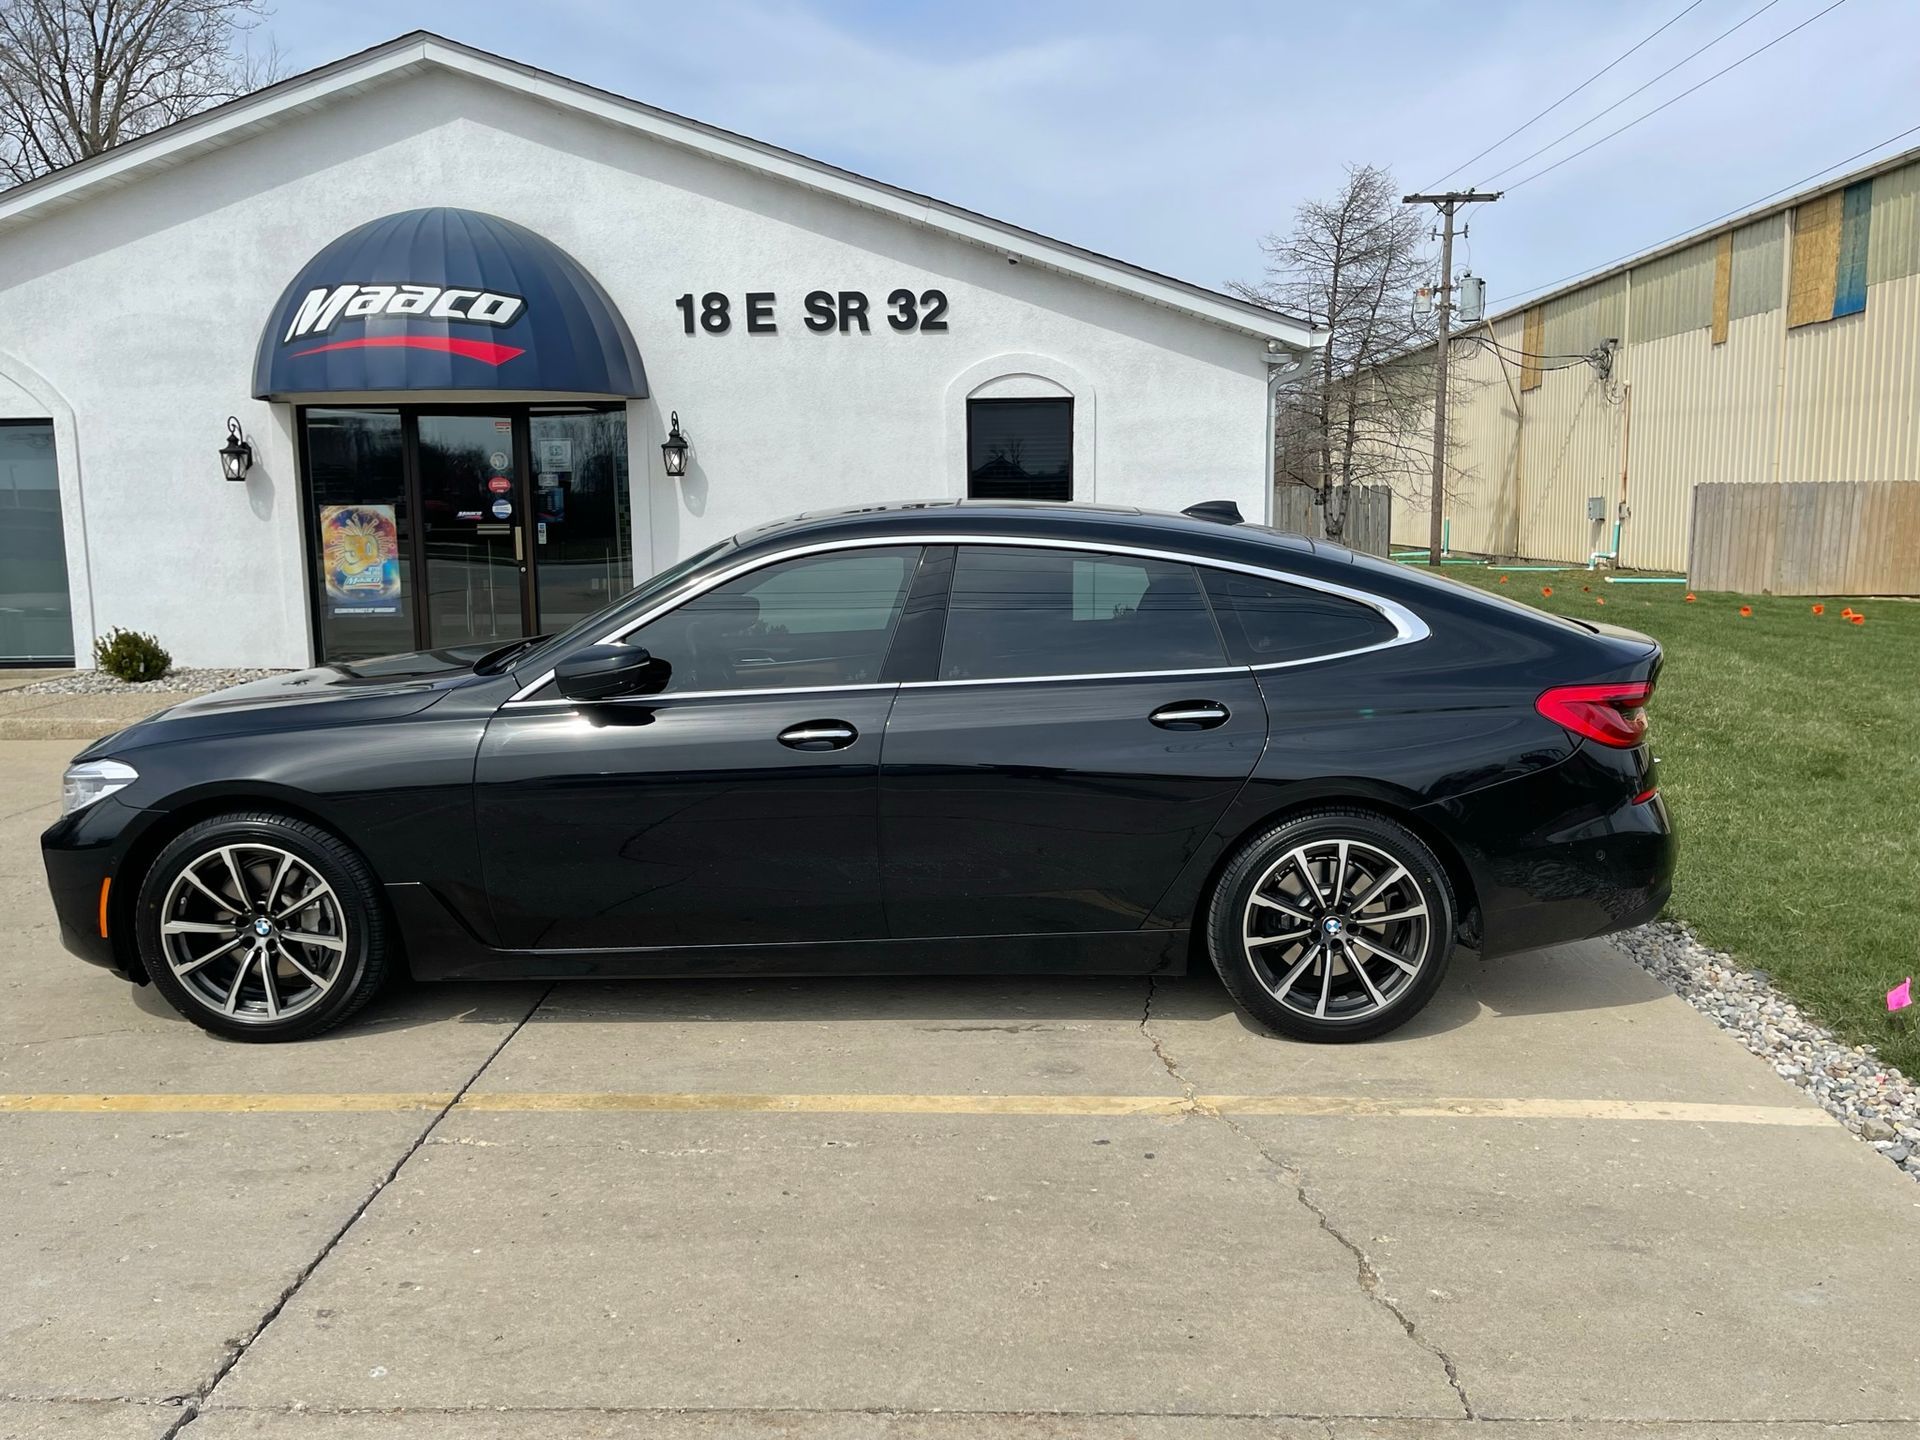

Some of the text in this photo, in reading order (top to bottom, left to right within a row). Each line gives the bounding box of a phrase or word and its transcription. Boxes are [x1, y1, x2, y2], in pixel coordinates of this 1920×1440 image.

[284, 284, 523, 343] Maaco
[675, 288, 948, 334] 18 E SR 32
